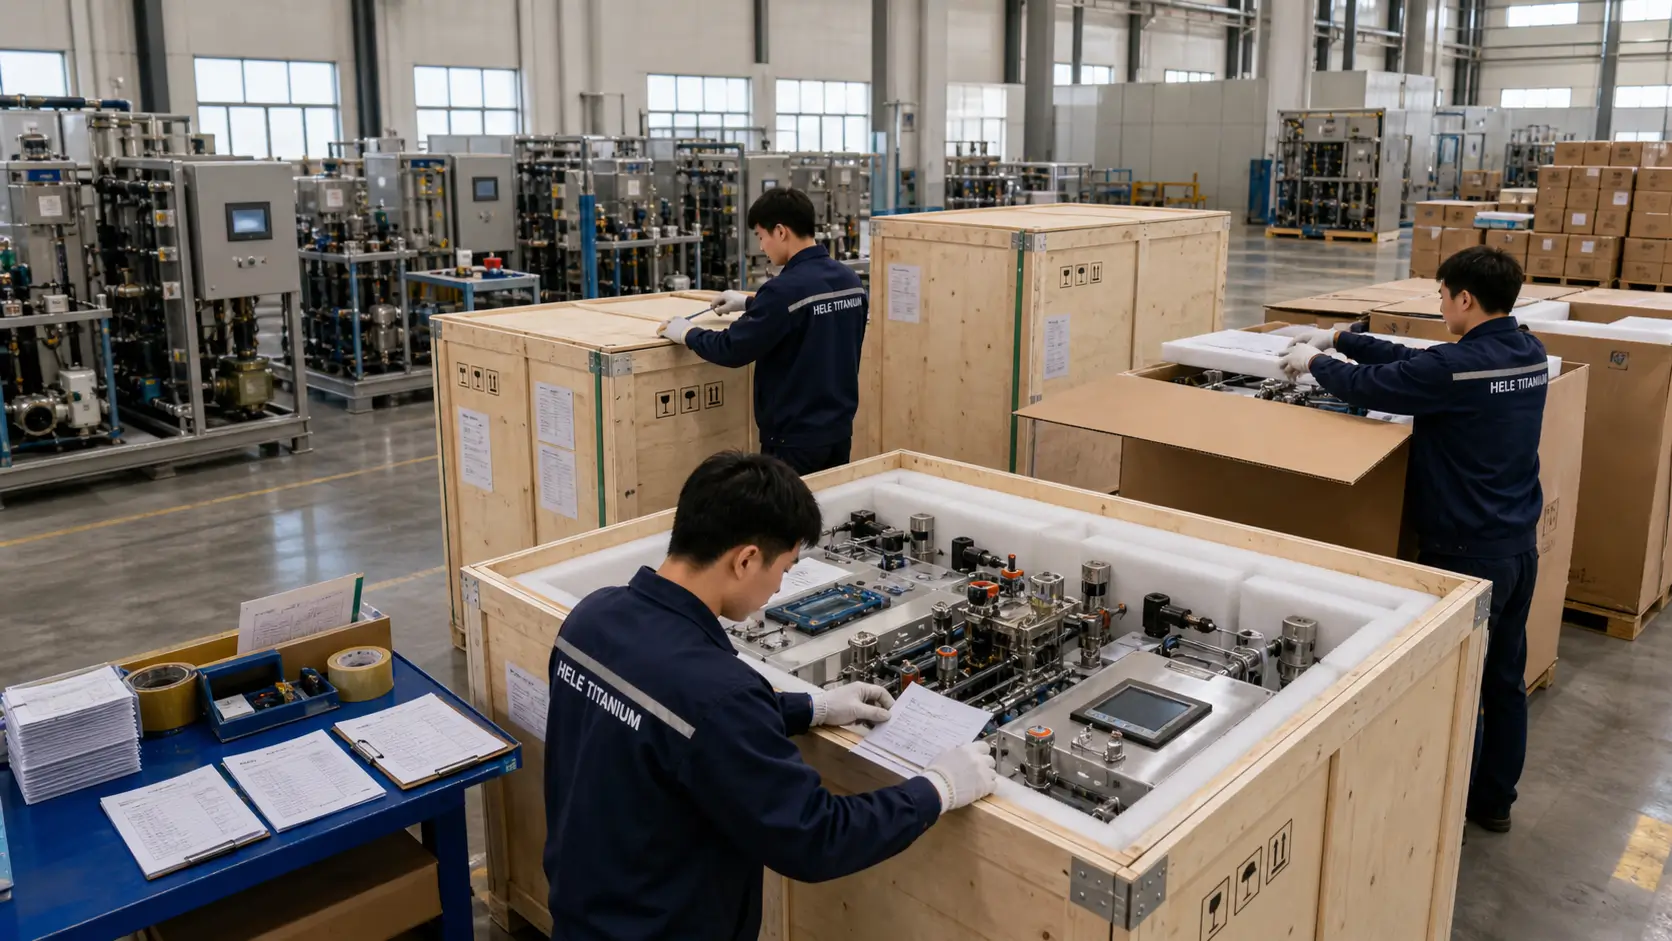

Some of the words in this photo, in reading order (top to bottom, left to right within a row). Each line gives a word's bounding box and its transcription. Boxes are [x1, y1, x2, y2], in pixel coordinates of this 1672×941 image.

[813, 302, 833, 315] HELE
[833, 297, 862, 311] TITANIUM
[1490, 379, 1515, 394] HELE
[557, 660, 585, 692] HELE
[586, 680, 642, 731] TITANIUM
